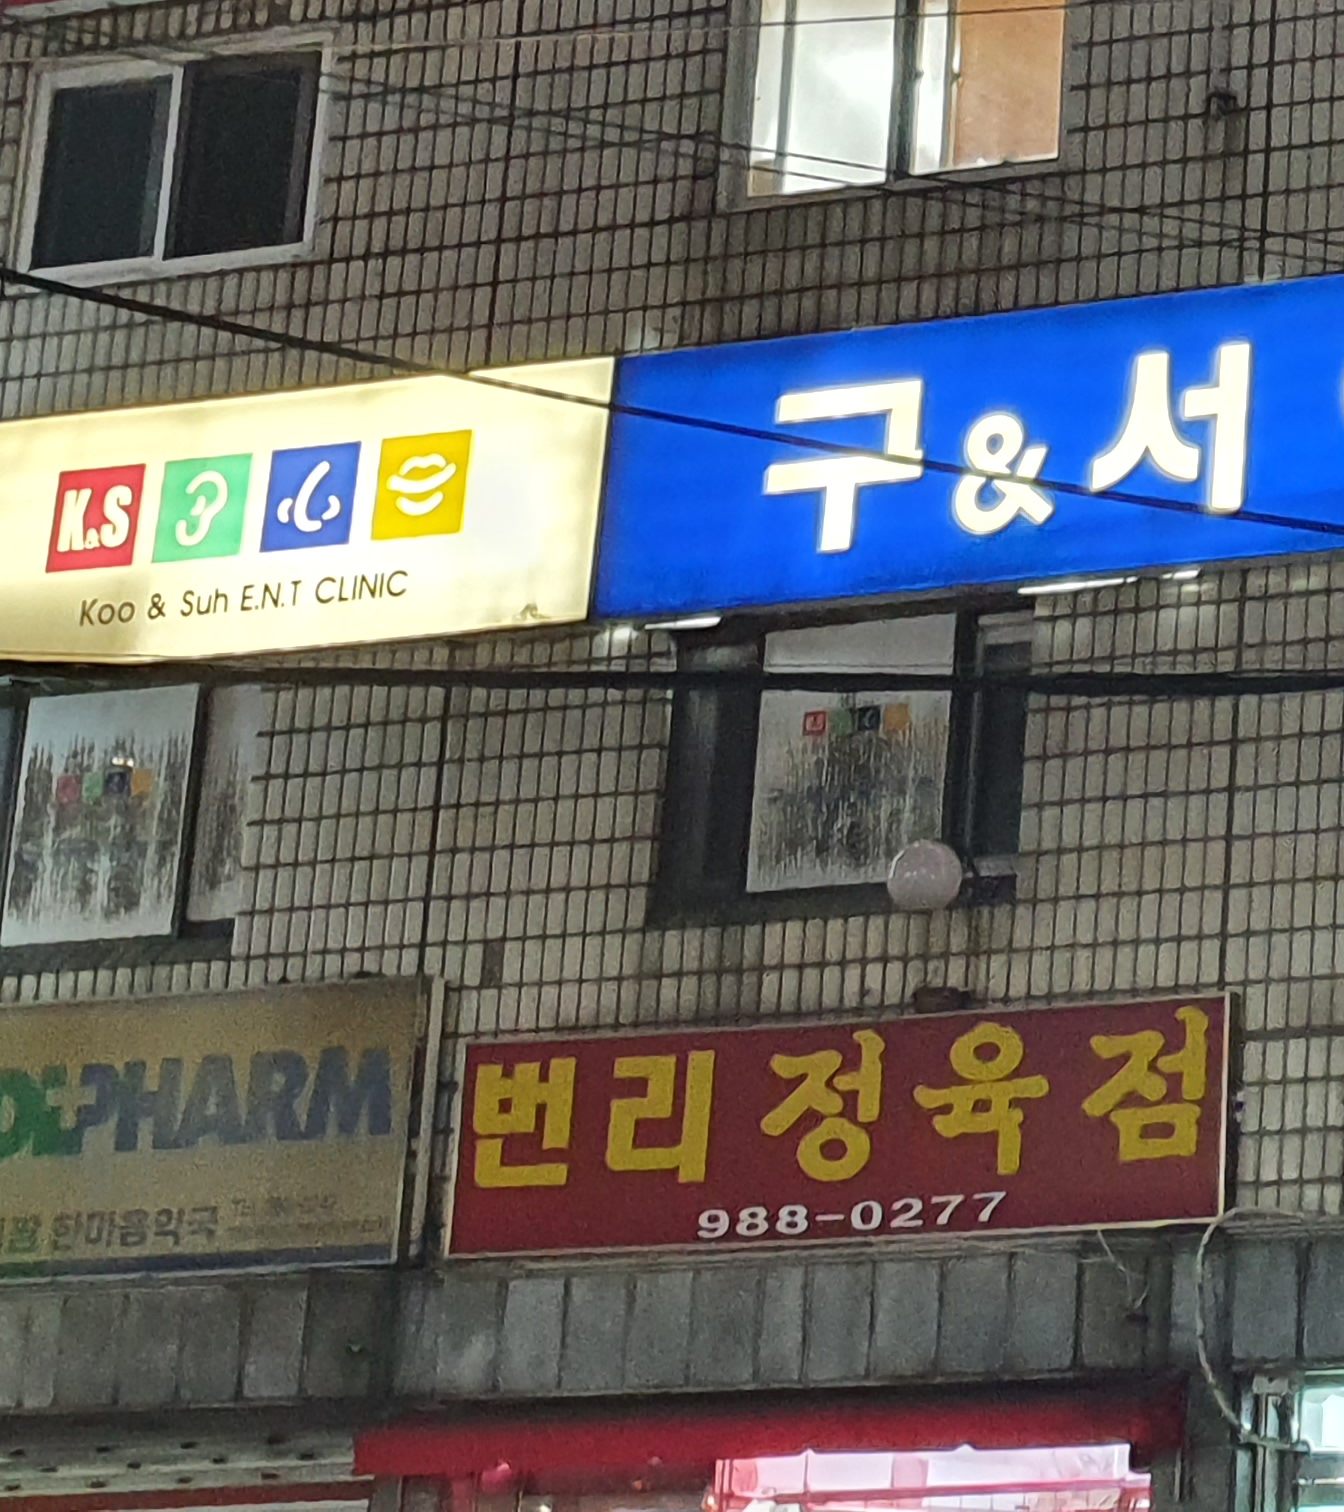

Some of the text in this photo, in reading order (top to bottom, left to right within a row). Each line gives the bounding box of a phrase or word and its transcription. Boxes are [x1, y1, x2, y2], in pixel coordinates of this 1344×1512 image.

[79, 569, 409, 628] Koo & Suh E.N.T CLINIC
[697, 1191, 1007, 1238] 988-0277
